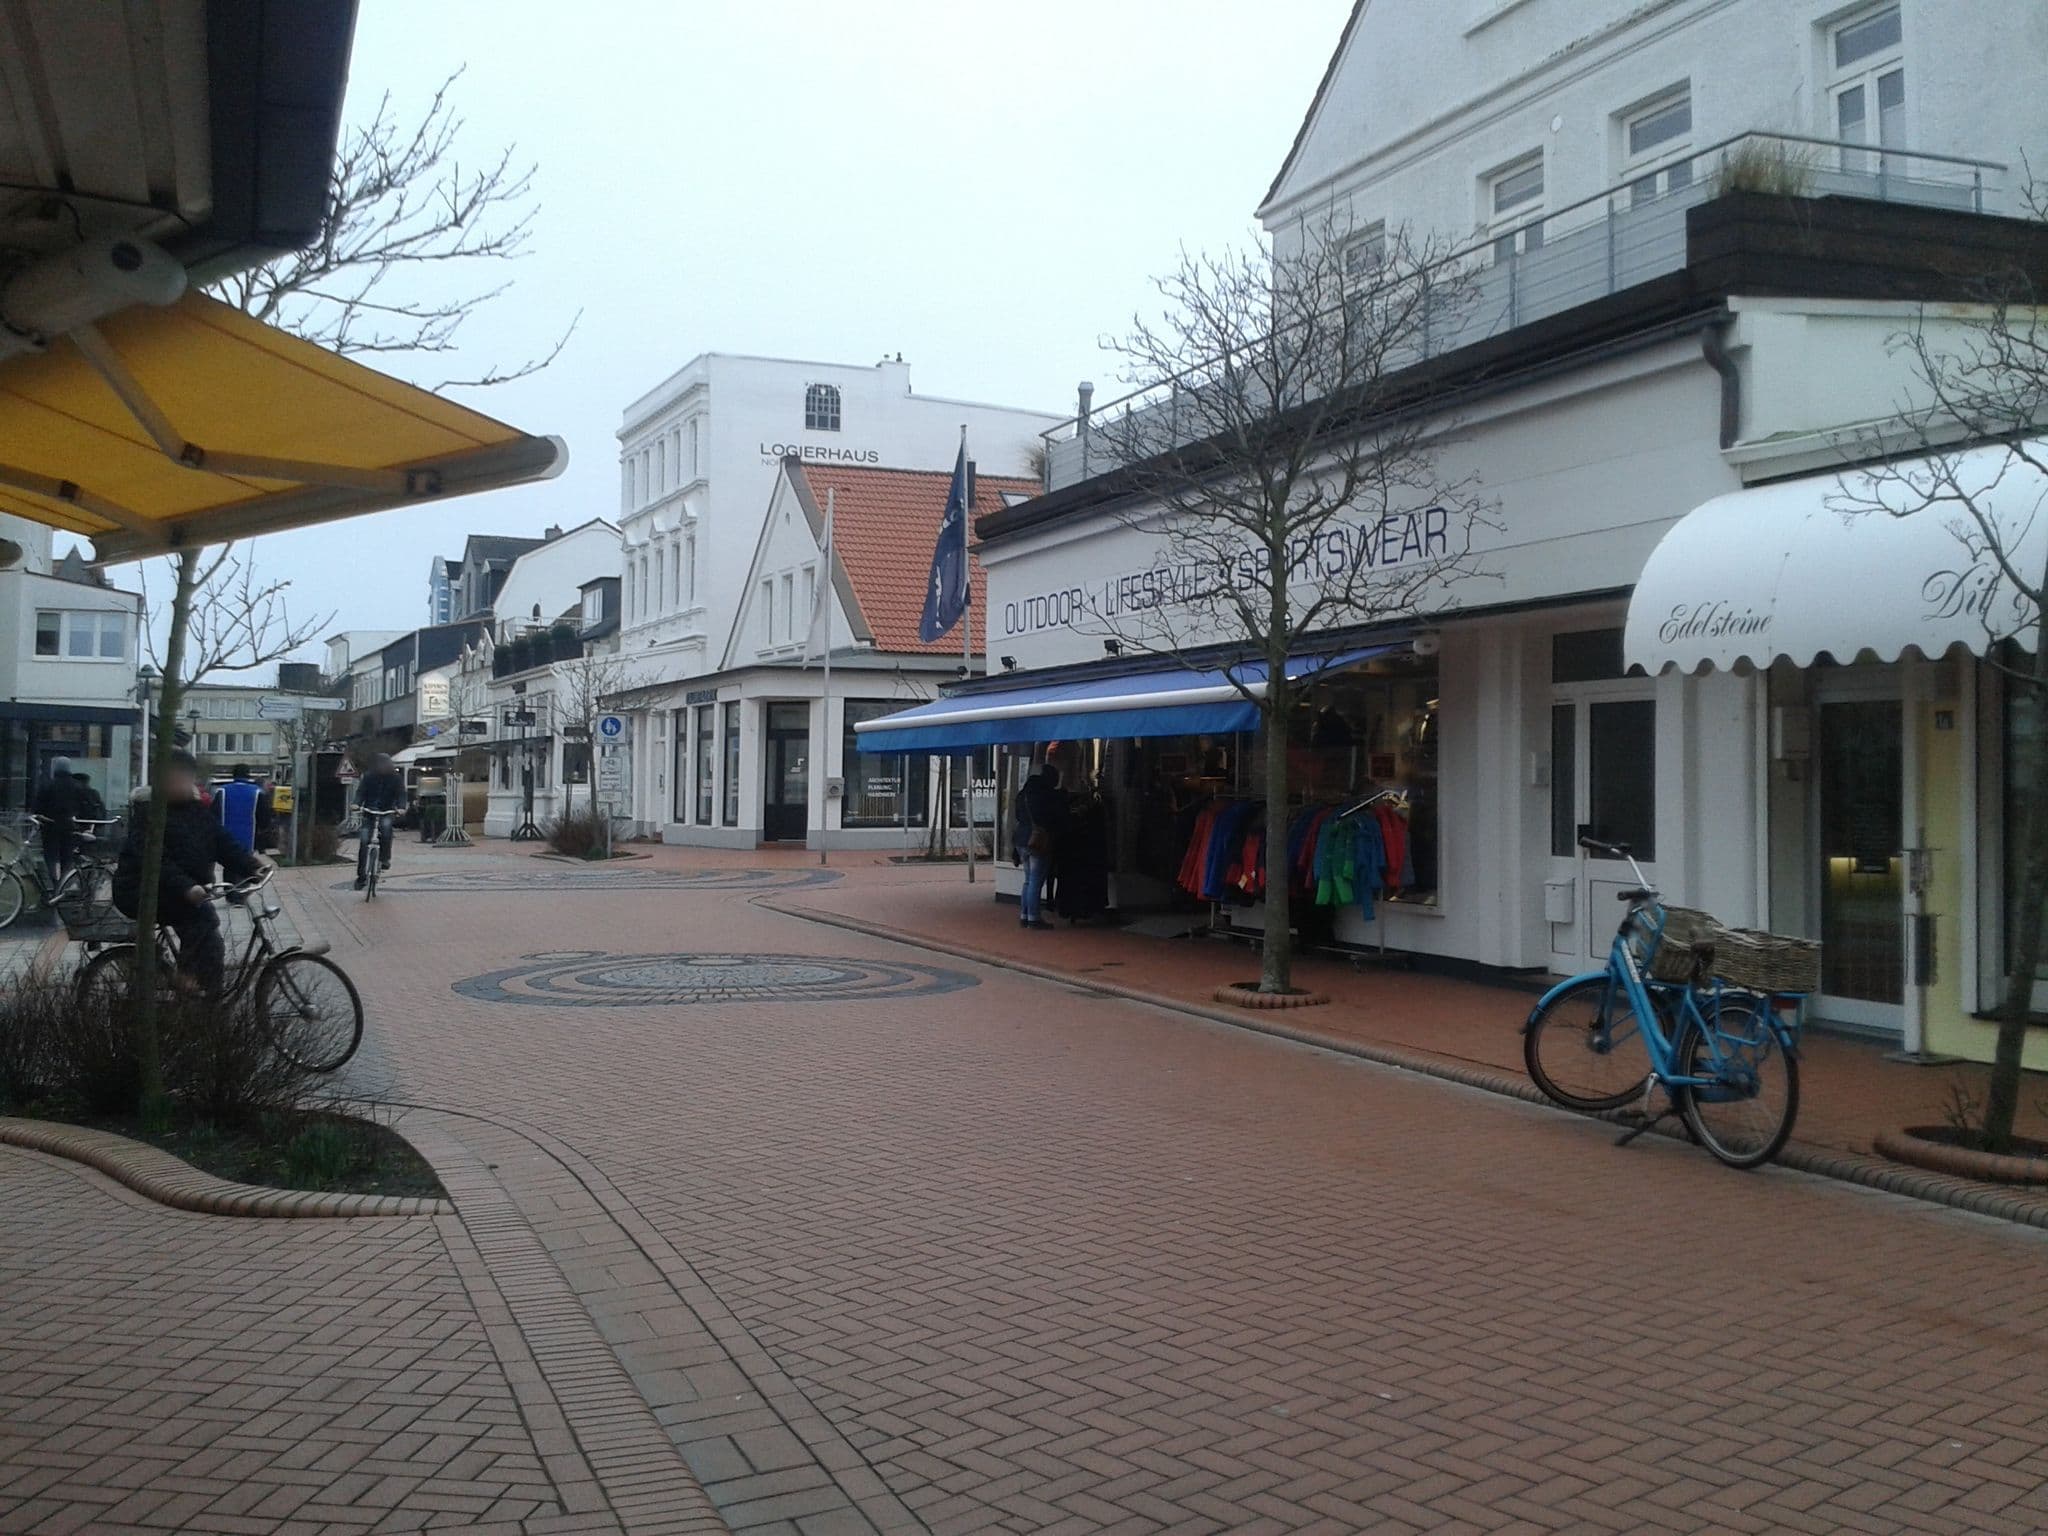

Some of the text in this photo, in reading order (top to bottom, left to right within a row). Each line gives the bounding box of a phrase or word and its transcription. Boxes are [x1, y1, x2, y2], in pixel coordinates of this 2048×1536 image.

[760, 442, 879, 463] LOGIERHAUS
[1005, 588, 1083, 635] OUTDOOR
[1105, 563, 1206, 616] LIFESTYLE
[1658, 600, 1773, 645] Edelsteine
